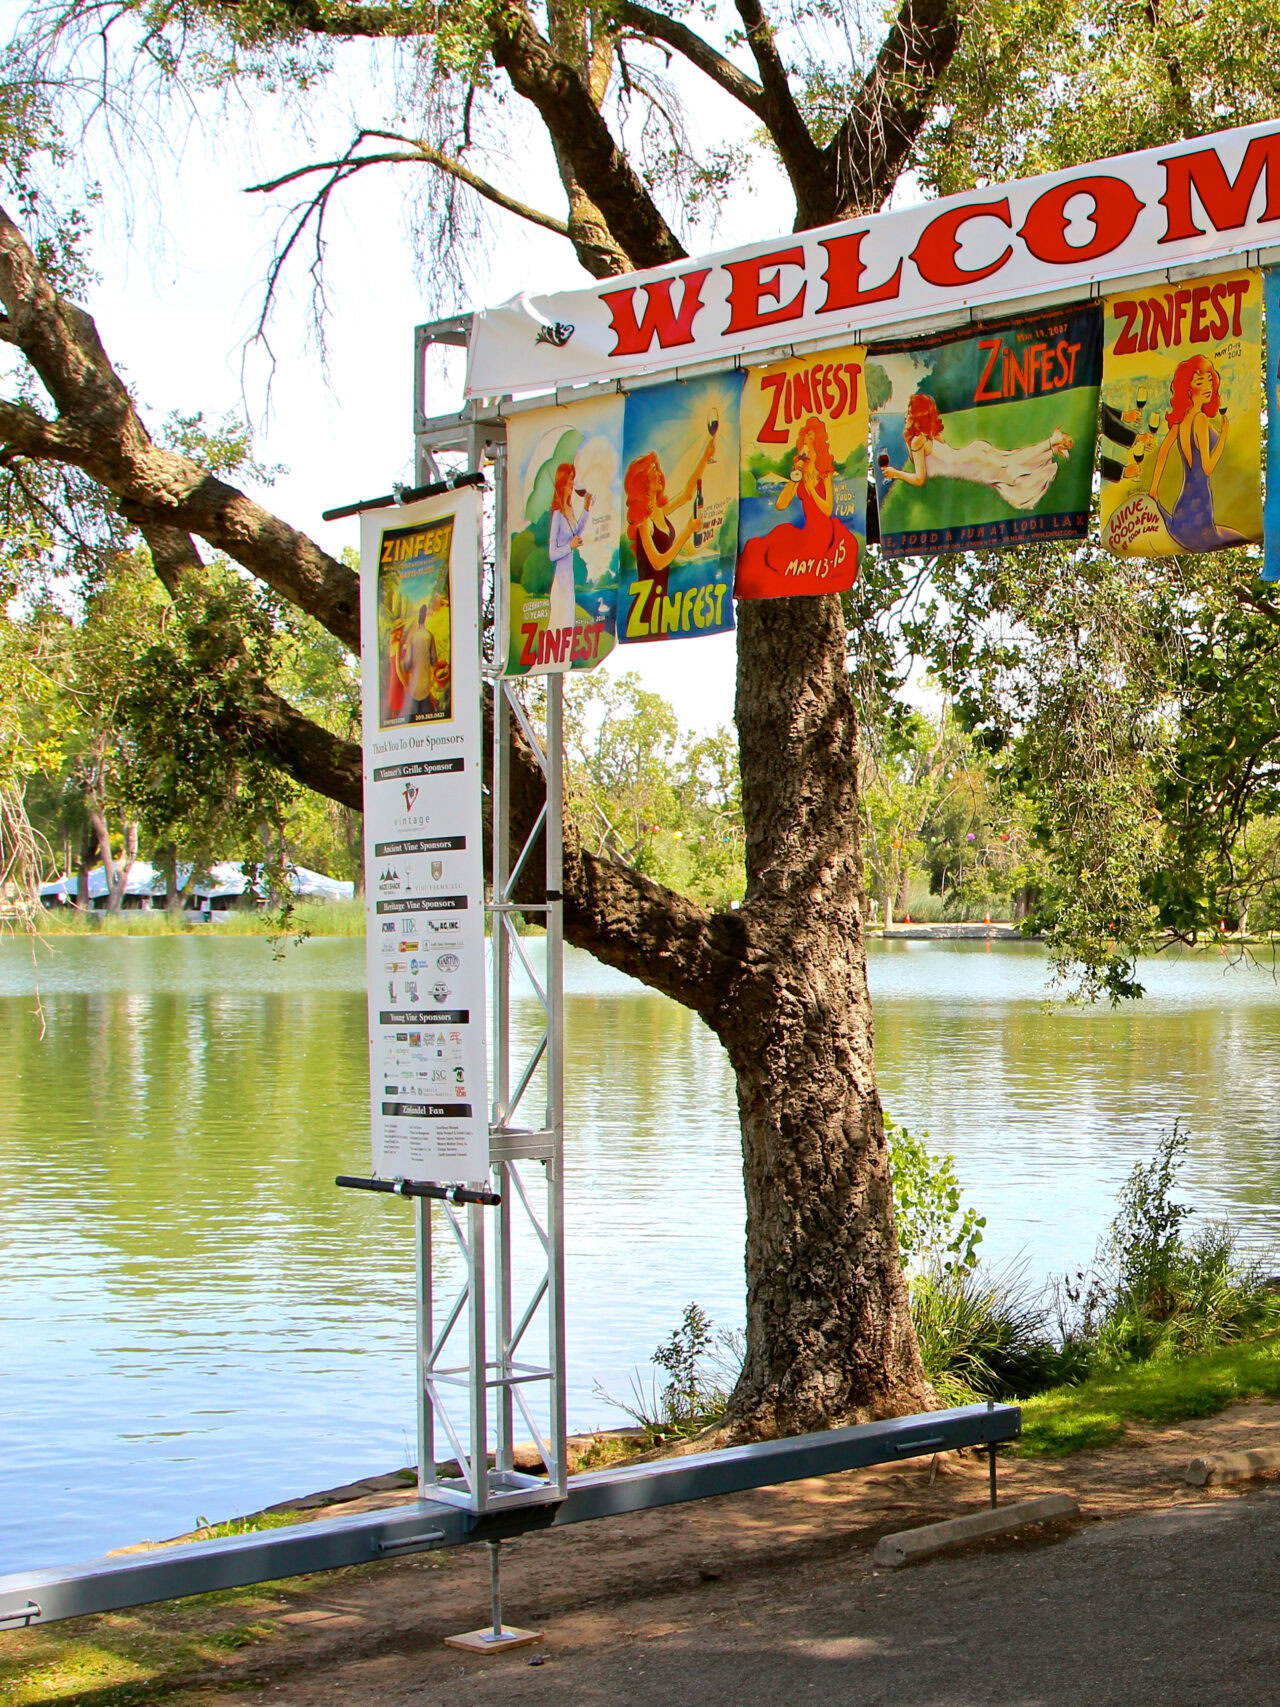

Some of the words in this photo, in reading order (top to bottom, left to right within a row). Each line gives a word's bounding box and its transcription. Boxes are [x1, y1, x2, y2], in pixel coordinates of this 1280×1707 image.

[1113, 279, 1250, 355] ZINFEST
[757, 363, 862, 444] ZINFEST
[1109, 521, 1135, 551] FOOD
[1141, 512, 1159, 525] FUN
[381, 525, 452, 563] ZINFEST
[784, 558, 814, 577] MAY
[520, 622, 605, 667] ZINFEST
[388, 741, 399, 752] You
[400, 738, 408, 750] To
[409, 736, 424, 749] Our
[425, 734, 465, 751] Sponsors
[402, 764, 423, 775] Grille
[424, 762, 453, 773] Sponsor
[404, 842, 419, 851] Vine
[420, 840, 452, 851] Sponsors
[383, 902, 405, 911] Heritage
[406, 900, 420, 909] Vine
[421, 899, 456, 909] Sponsors
[405, 1013, 418, 1021] Vine
[419, 1013, 452, 1022] Sponsors
[429, 1106, 444, 1115] Fan
